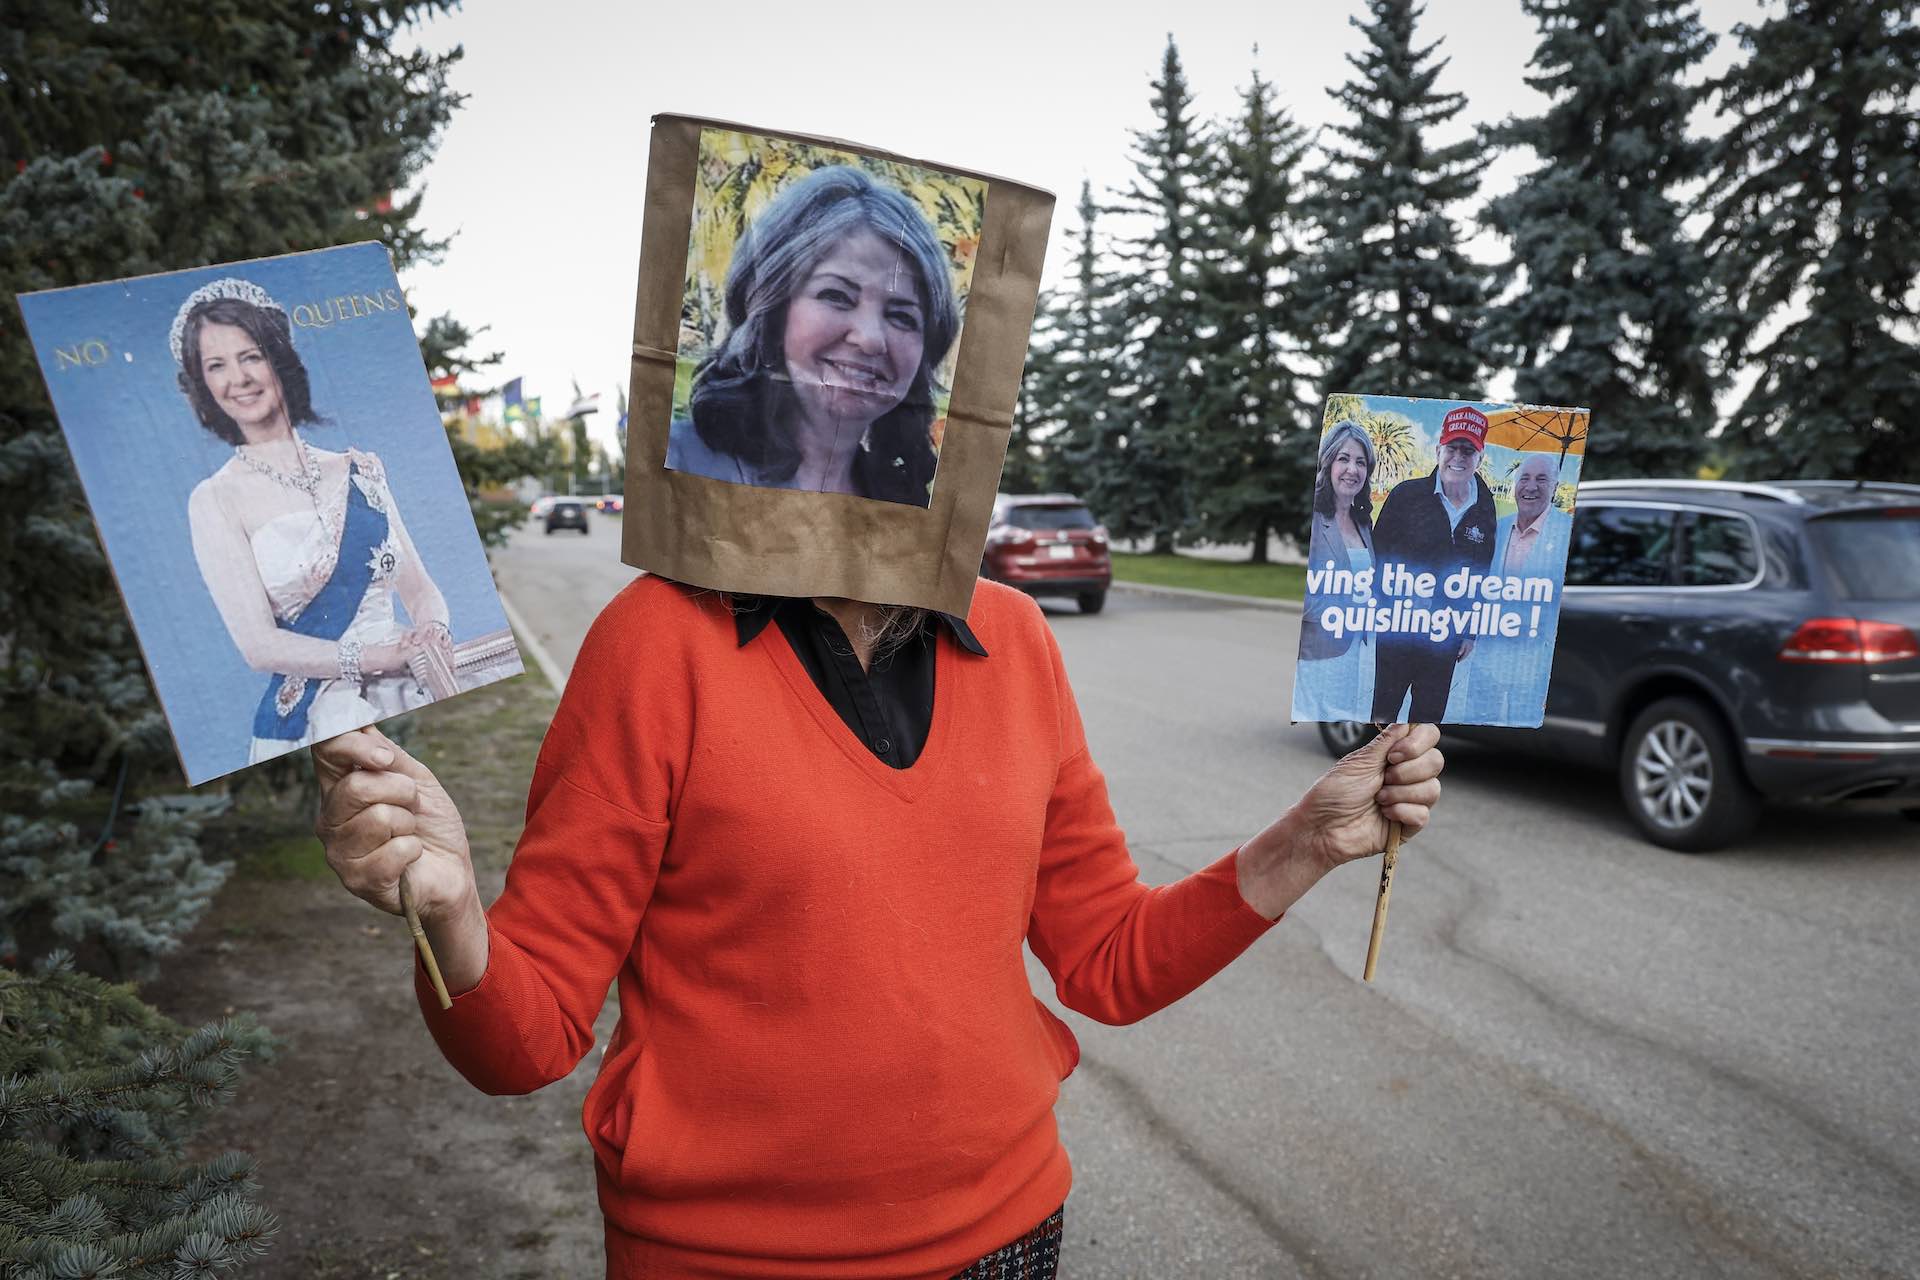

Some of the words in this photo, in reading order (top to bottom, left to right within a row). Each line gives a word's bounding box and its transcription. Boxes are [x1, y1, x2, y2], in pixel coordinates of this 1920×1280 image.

[55, 340, 109, 371] NO
[293, 289, 401, 328] QUEENS
[1448, 412, 1464, 422] MAKE
[1449, 422, 1467, 432] GREAT
[1306, 559, 1375, 603] ving
[1382, 562, 1436, 597] the
[1443, 566, 1553, 603] dream
[1320, 598, 1522, 643] quislingville
[1529, 605, 1541, 638] !
